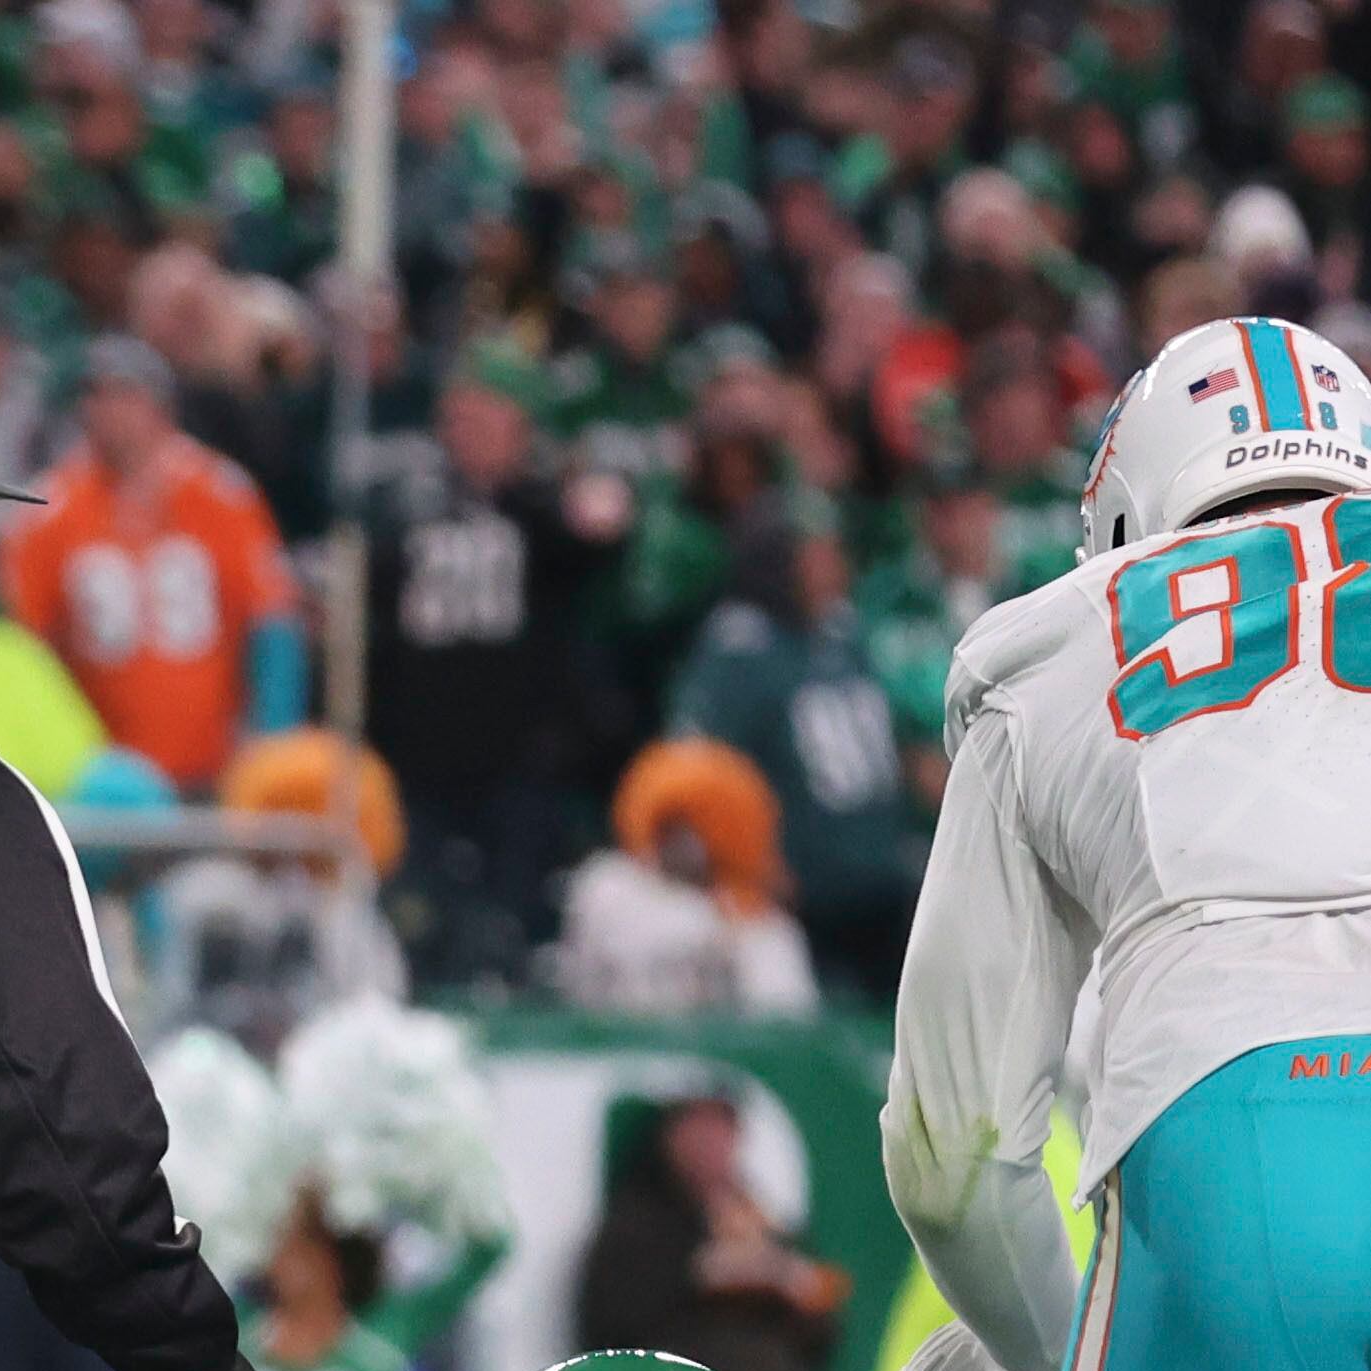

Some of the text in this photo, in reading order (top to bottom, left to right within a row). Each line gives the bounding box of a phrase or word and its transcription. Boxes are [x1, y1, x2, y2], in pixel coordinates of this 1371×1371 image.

[1229, 401, 1338, 434] 9 8
[1226, 438, 1368, 470] Dolphins
[1106, 488, 1371, 742] 9
